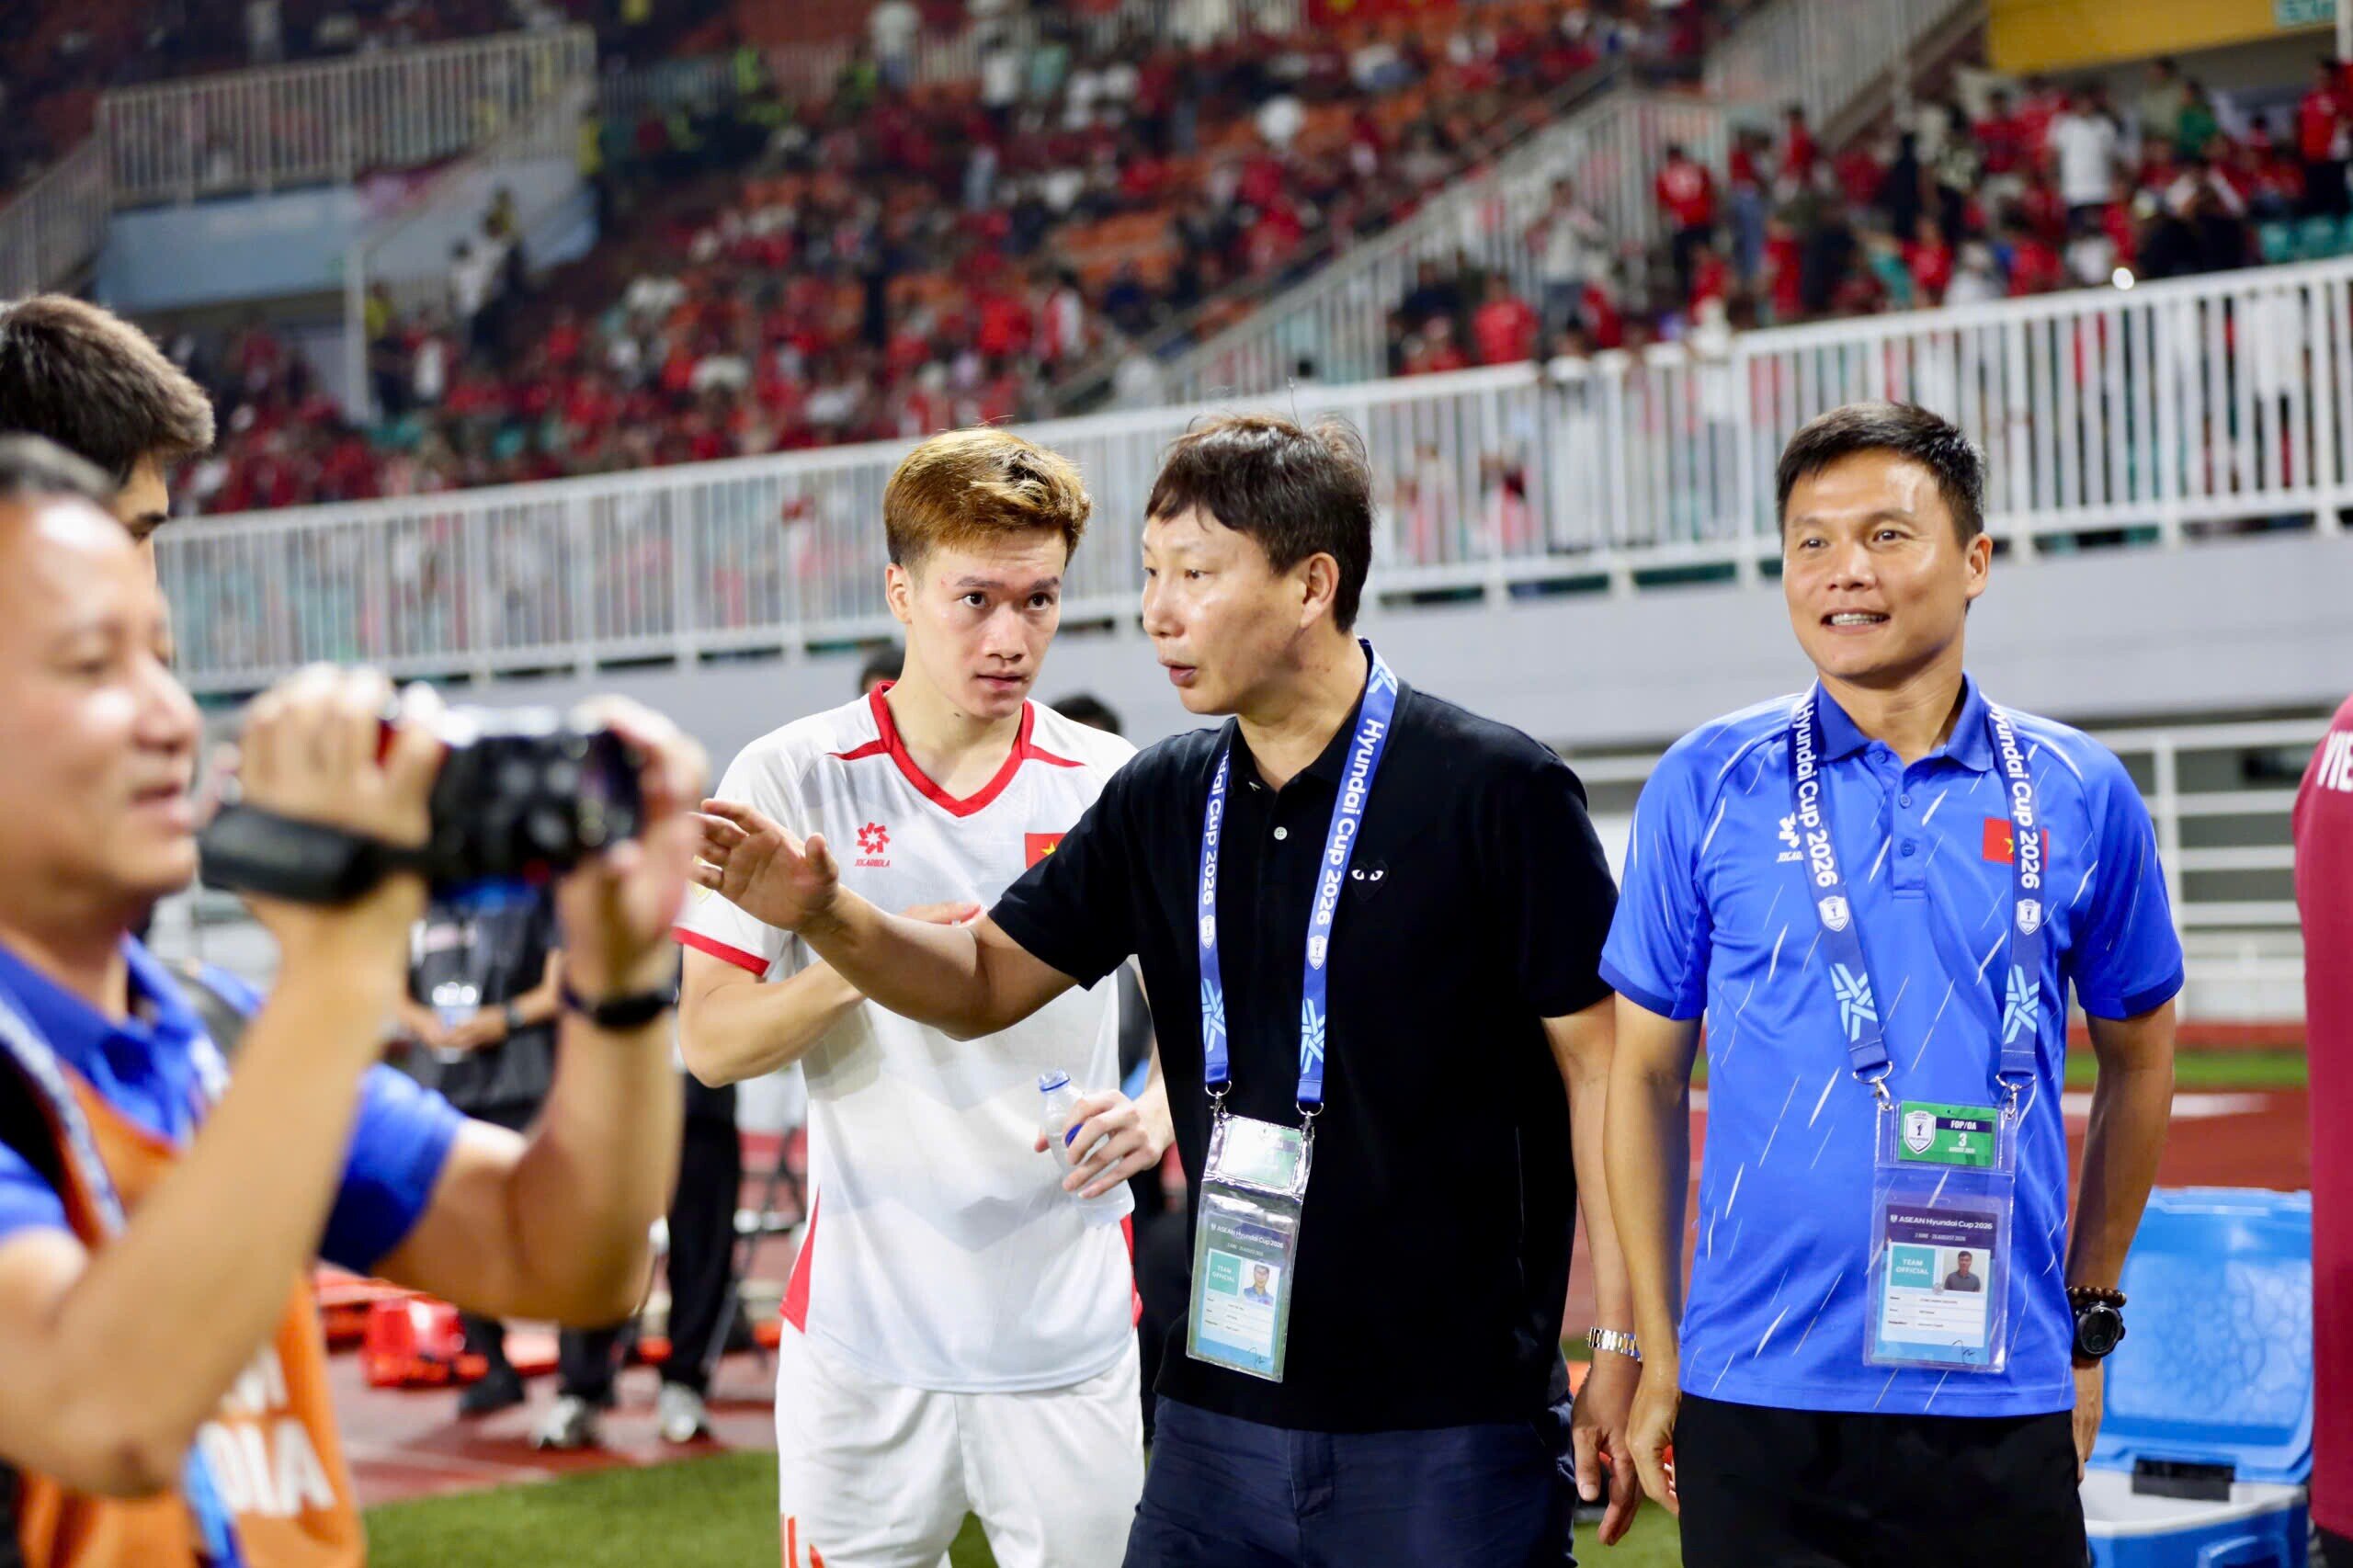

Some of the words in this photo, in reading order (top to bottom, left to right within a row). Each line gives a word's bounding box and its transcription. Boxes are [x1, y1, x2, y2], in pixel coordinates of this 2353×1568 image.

[1792, 701, 1818, 782] Hyundai
[1989, 707, 2030, 779] yundai
[1342, 719, 1385, 815] Hyundai
[1205, 799, 1222, 846] Cup
[1798, 781, 1820, 828] Cup
[2012, 781, 2033, 827] Cup
[1328, 817, 1356, 866] Cup
[1806, 828, 1838, 888] 2026
[2019, 830, 2040, 890] 2026
[1203, 850, 1217, 905] 2026
[1316, 869, 1342, 926] 2026
[1958, 1132, 1968, 1147] 3
[1898, 1215, 1926, 1225] ASEAN
[1927, 1218, 1958, 1228] Hyundai
[1958, 1221, 1974, 1229] Cup
[1974, 1221, 1994, 1230] 2026
[1895, 1266, 1929, 1275] OFFICIAL
[1903, 1258, 1924, 1267] TEAM
